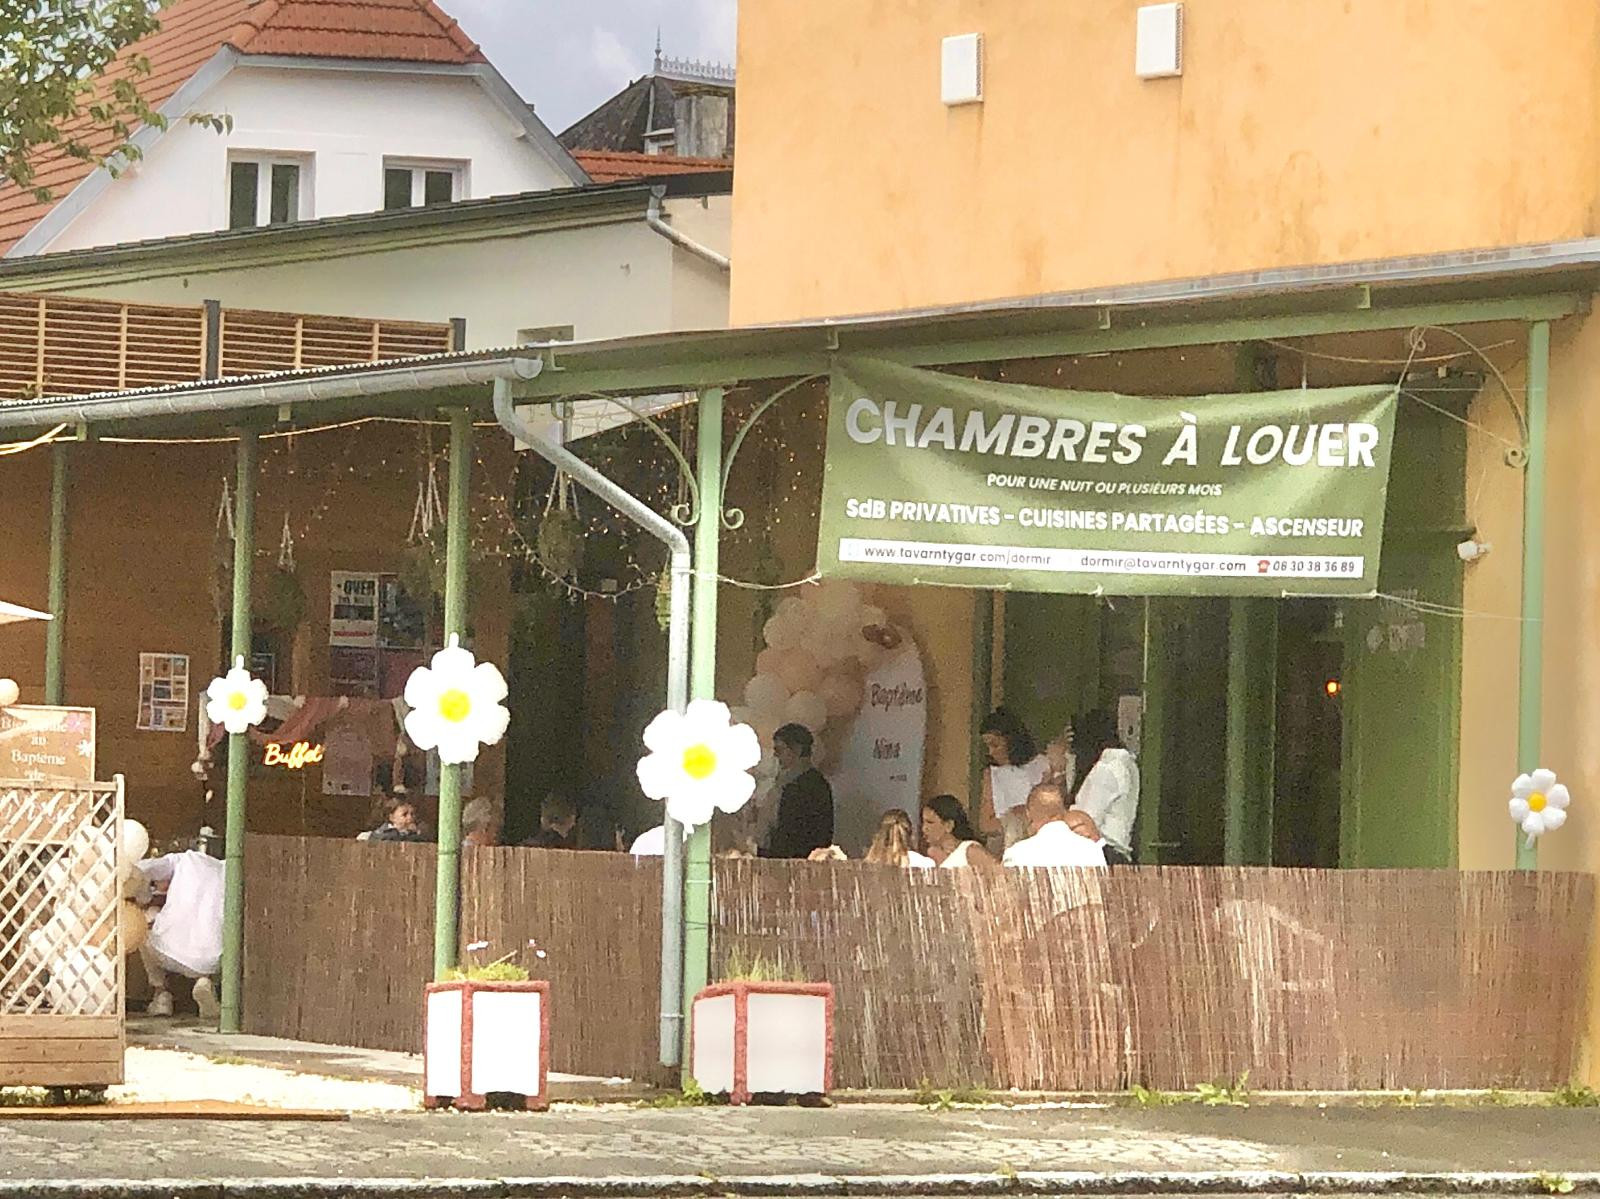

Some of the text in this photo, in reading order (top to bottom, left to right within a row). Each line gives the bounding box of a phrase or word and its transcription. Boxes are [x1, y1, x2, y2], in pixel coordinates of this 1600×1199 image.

[845, 397, 1380, 467] CHAMBRES À LOUER
[987, 473, 1223, 496] POUR UNE NUIT OU PLUSIEURS MOIS
[846, 498, 886, 519] SdB
[890, 501, 1000, 526] PRIVATIVES
[1018, 508, 1108, 530] CUISINES
[1111, 509, 1230, 535] PARTAGÉES
[1249, 517, 1364, 538] ASCENSEUR
[1080, 555, 1247, 573] dormir@tavarntygar.com
[1290, 560, 1304, 572] 30
[1307, 560, 1321, 573] 38
[1324, 561, 1338, 573] 36
[1340, 561, 1355, 573] 89
[264, 741, 324, 769] Buffet
